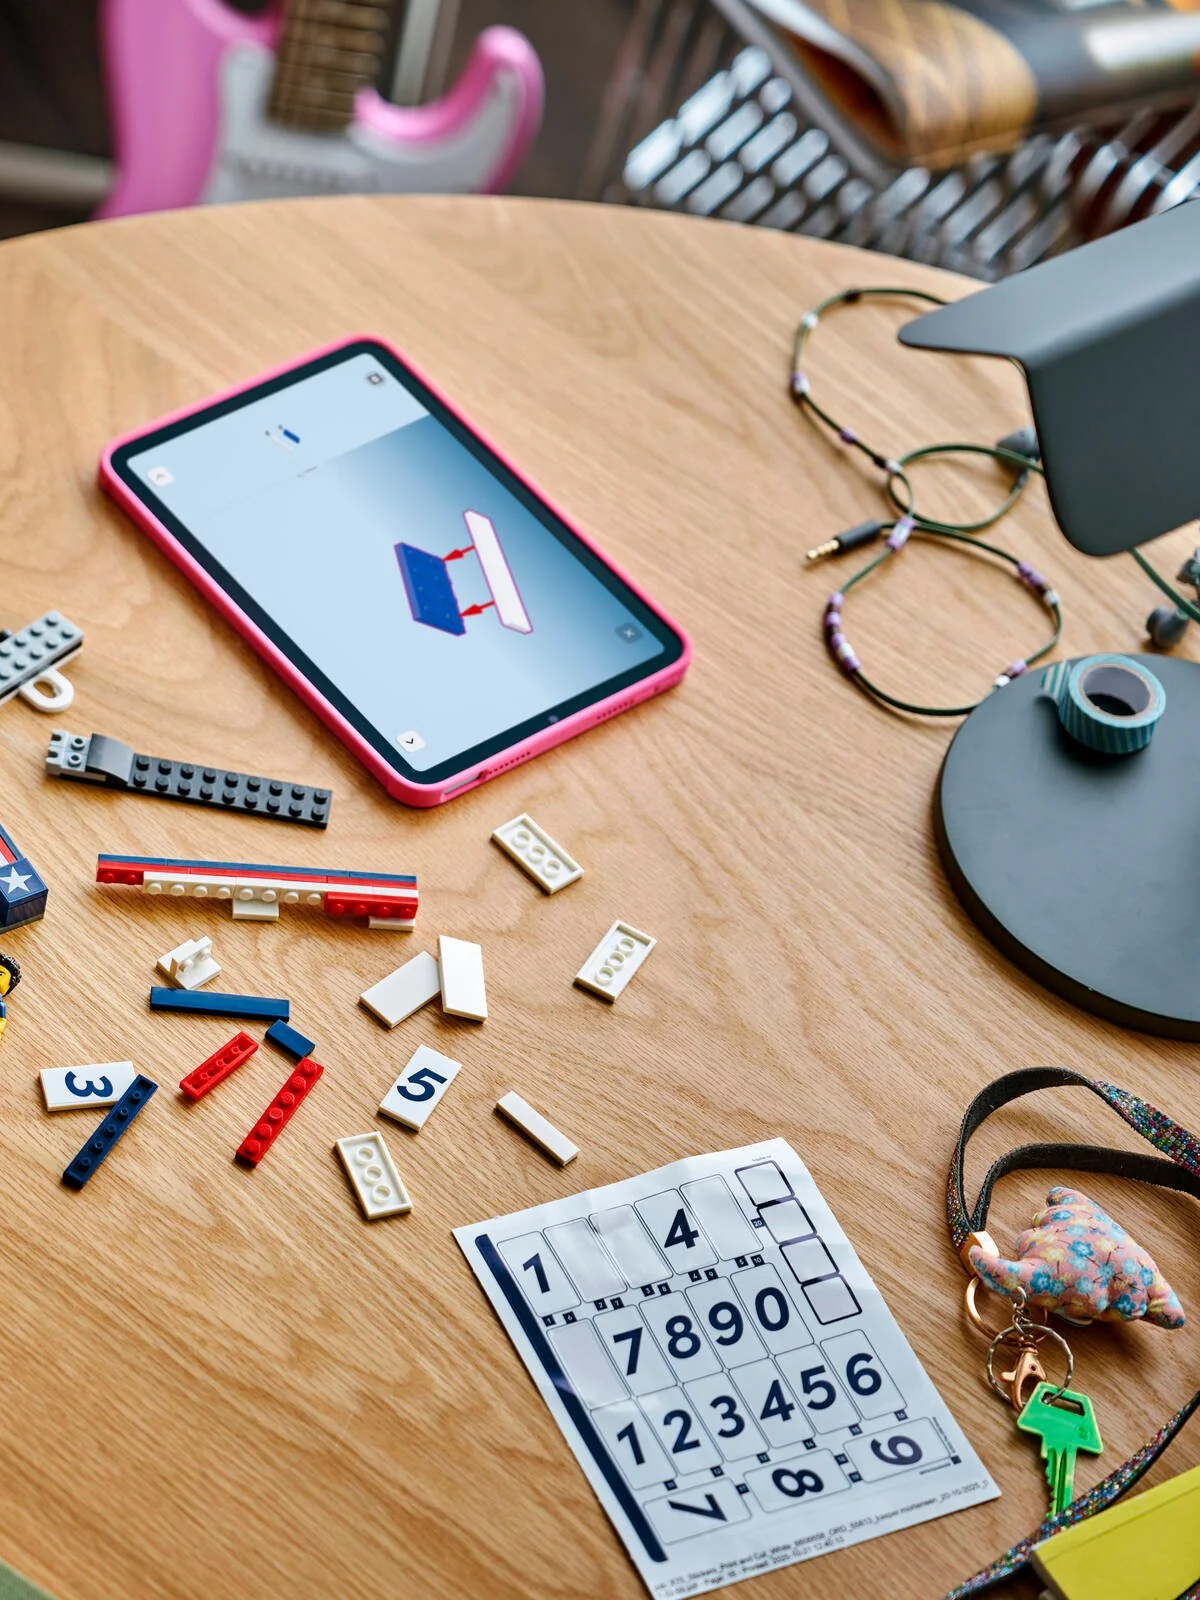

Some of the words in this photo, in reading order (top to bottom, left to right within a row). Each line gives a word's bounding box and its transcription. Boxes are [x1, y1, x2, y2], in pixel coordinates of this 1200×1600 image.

[64, 1071, 114, 1098] 3
[396, 1067, 448, 1102] 5
[522, 1253, 551, 1294] 1
[663, 1207, 700, 1249] 4
[612, 1326, 643, 1376] 7
[665, 1315, 701, 1360] 8
[708, 1301, 744, 1346] 9
[754, 1286, 790, 1332] 0
[616, 1422, 646, 1466] 1
[663, 1409, 701, 1454] 2
[709, 1395, 745, 1439] 3
[759, 1379, 795, 1422] 4
[800, 1365, 837, 1411] 5
[846, 1352, 882, 1397] 6
[771, 1468, 824, 1498] 8
[668, 1494, 728, 1522] 7
